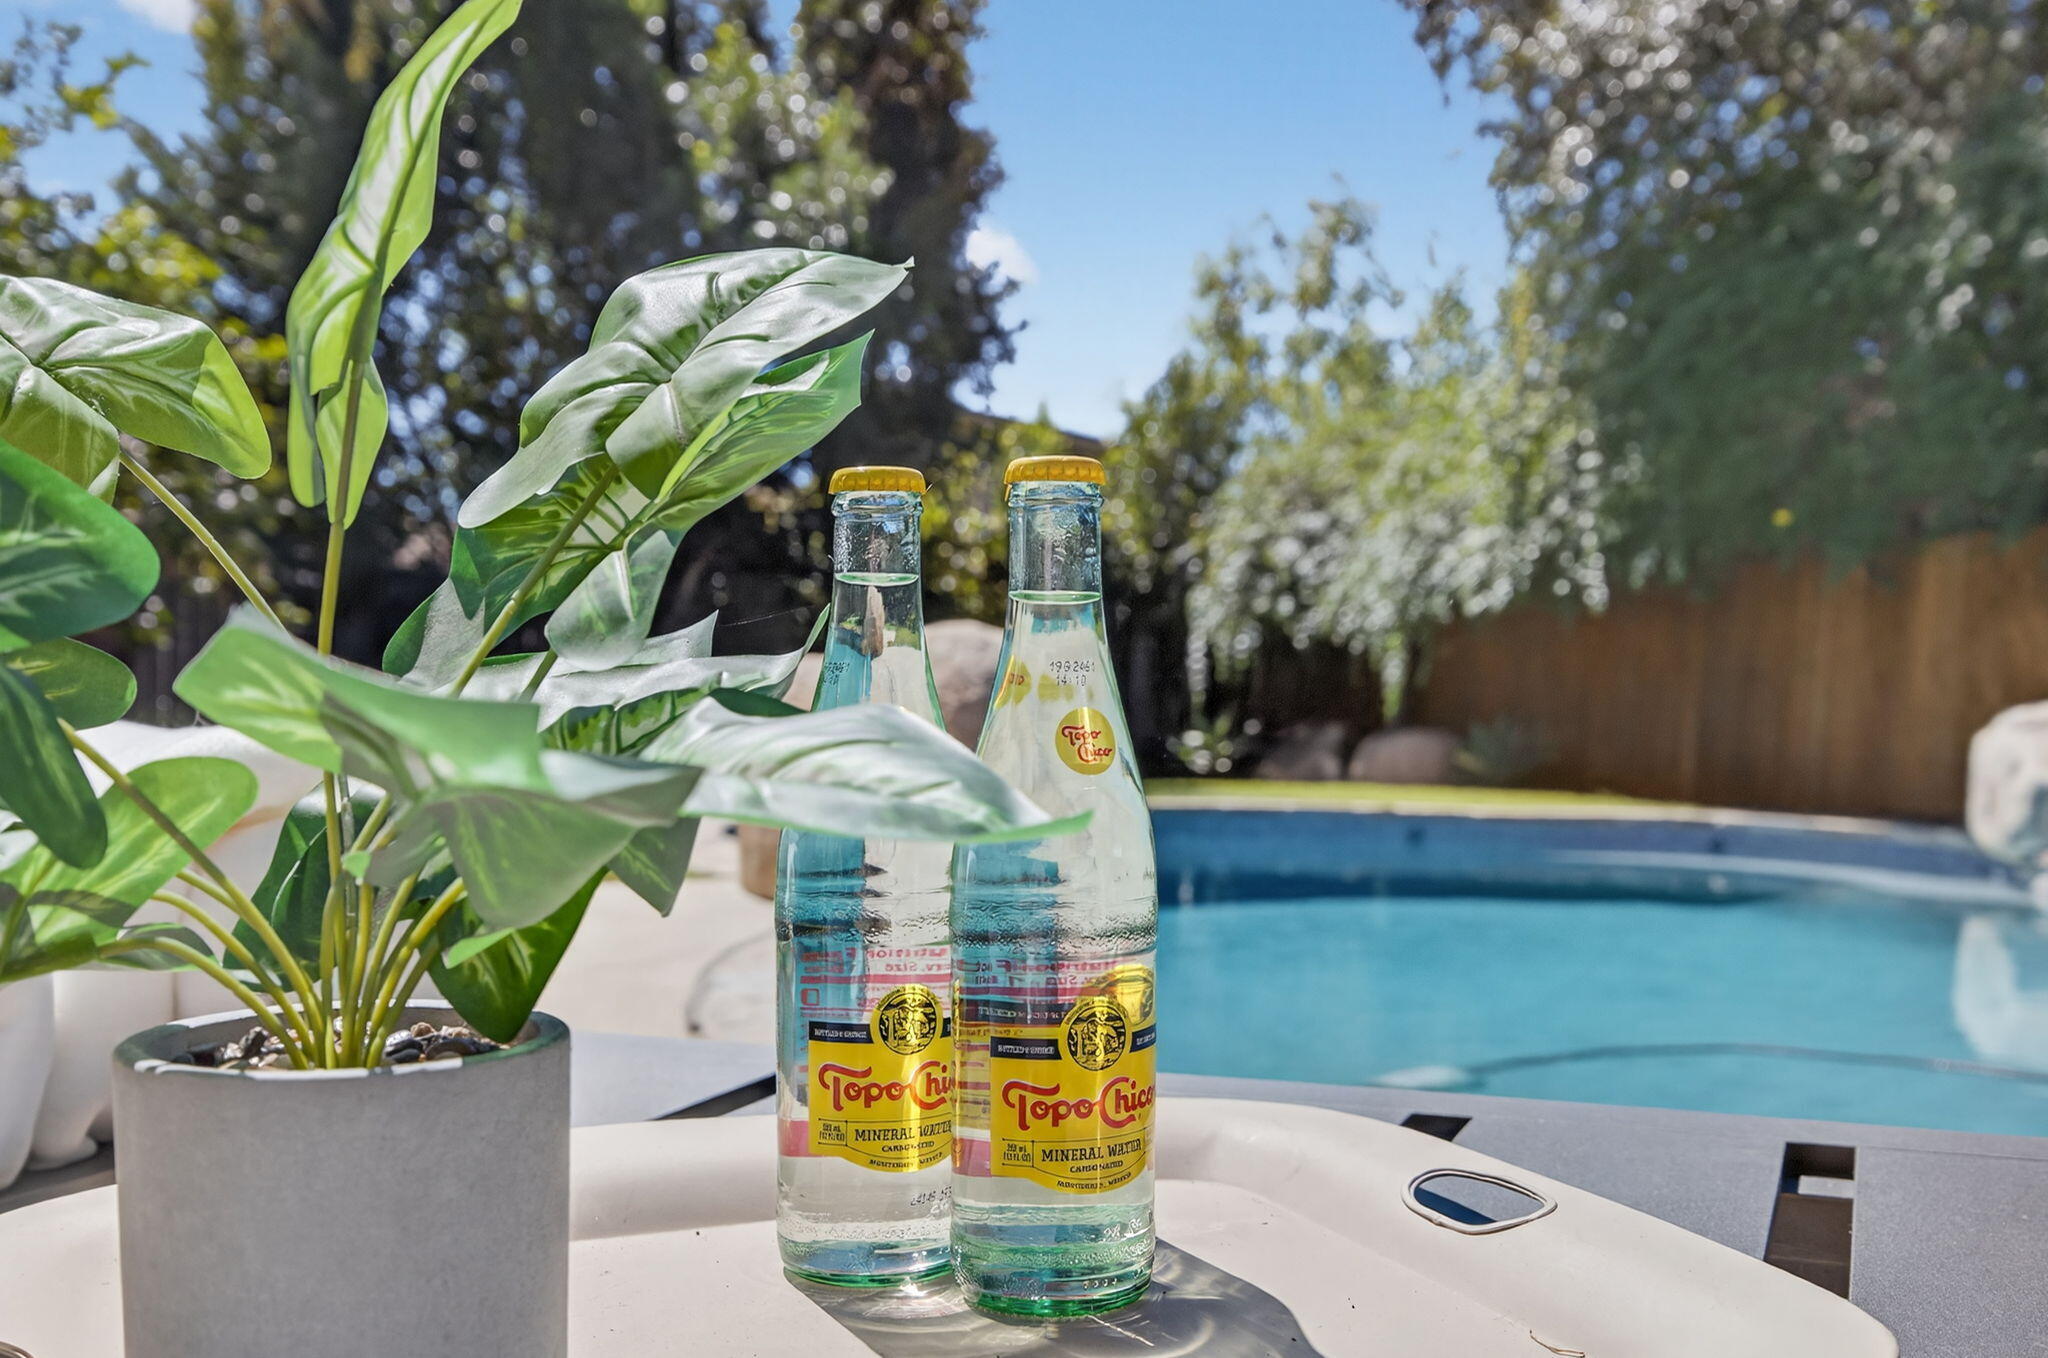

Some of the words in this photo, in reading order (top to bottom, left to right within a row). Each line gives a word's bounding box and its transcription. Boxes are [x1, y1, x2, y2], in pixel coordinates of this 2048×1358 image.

[1061, 725, 1102, 746] Topo
[1077, 743, 1113, 763] Chico
[818, 1062, 906, 1112] Topo
[909, 1060, 952, 1111] Chi
[1001, 1080, 1098, 1131] Topo
[1098, 1075, 1154, 1129] Chico
[854, 1126, 915, 1142] MINERAL
[1041, 1146, 1104, 1163] MINERAL
[1107, 1138, 1142, 1158] WATER
